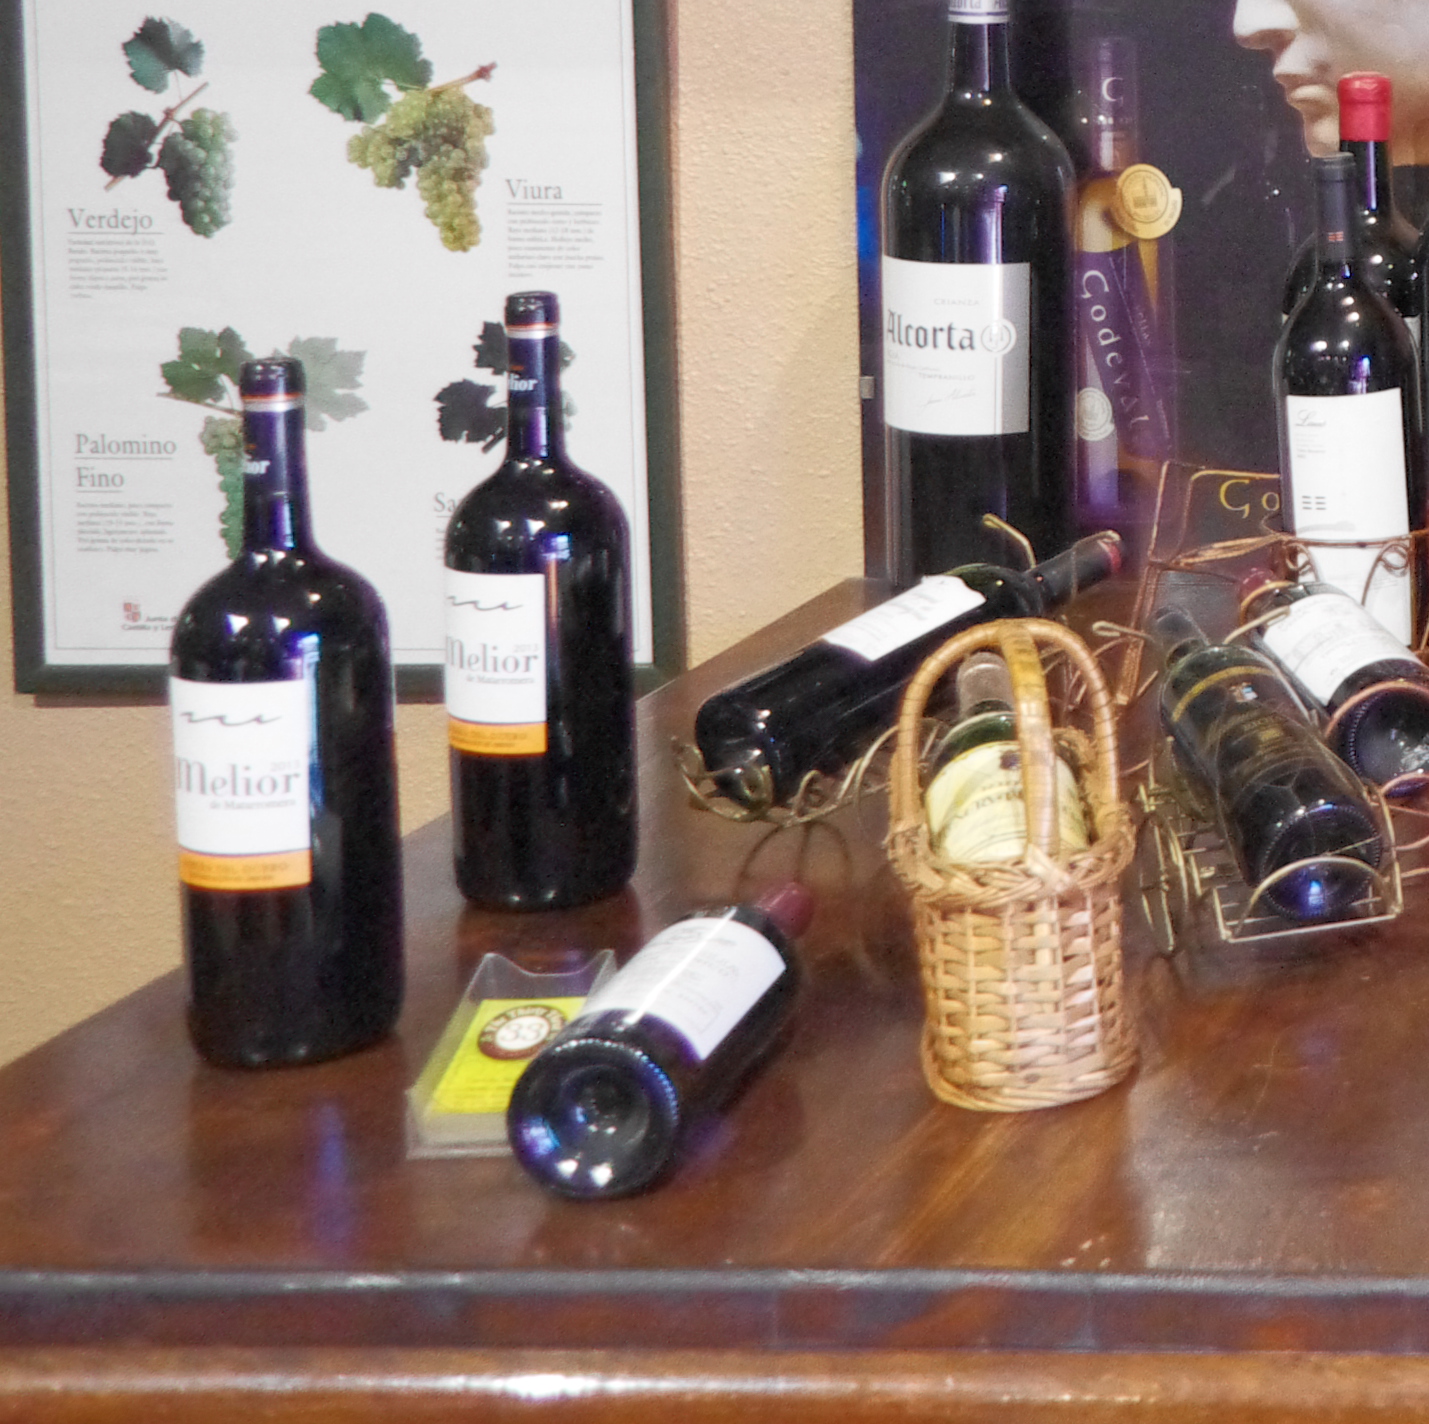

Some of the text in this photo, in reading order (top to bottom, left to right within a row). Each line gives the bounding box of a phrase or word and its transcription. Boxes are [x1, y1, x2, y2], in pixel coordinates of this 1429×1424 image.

[504, 178, 564, 200] Viura
[66, 207, 154, 235] Verdejo
[886, 309, 976, 351] Alcorta
[74, 433, 177, 455] Palomino
[76, 466, 125, 488] Fino
[445, 633, 539, 674] Melior
[176, 757, 301, 798] Melior
